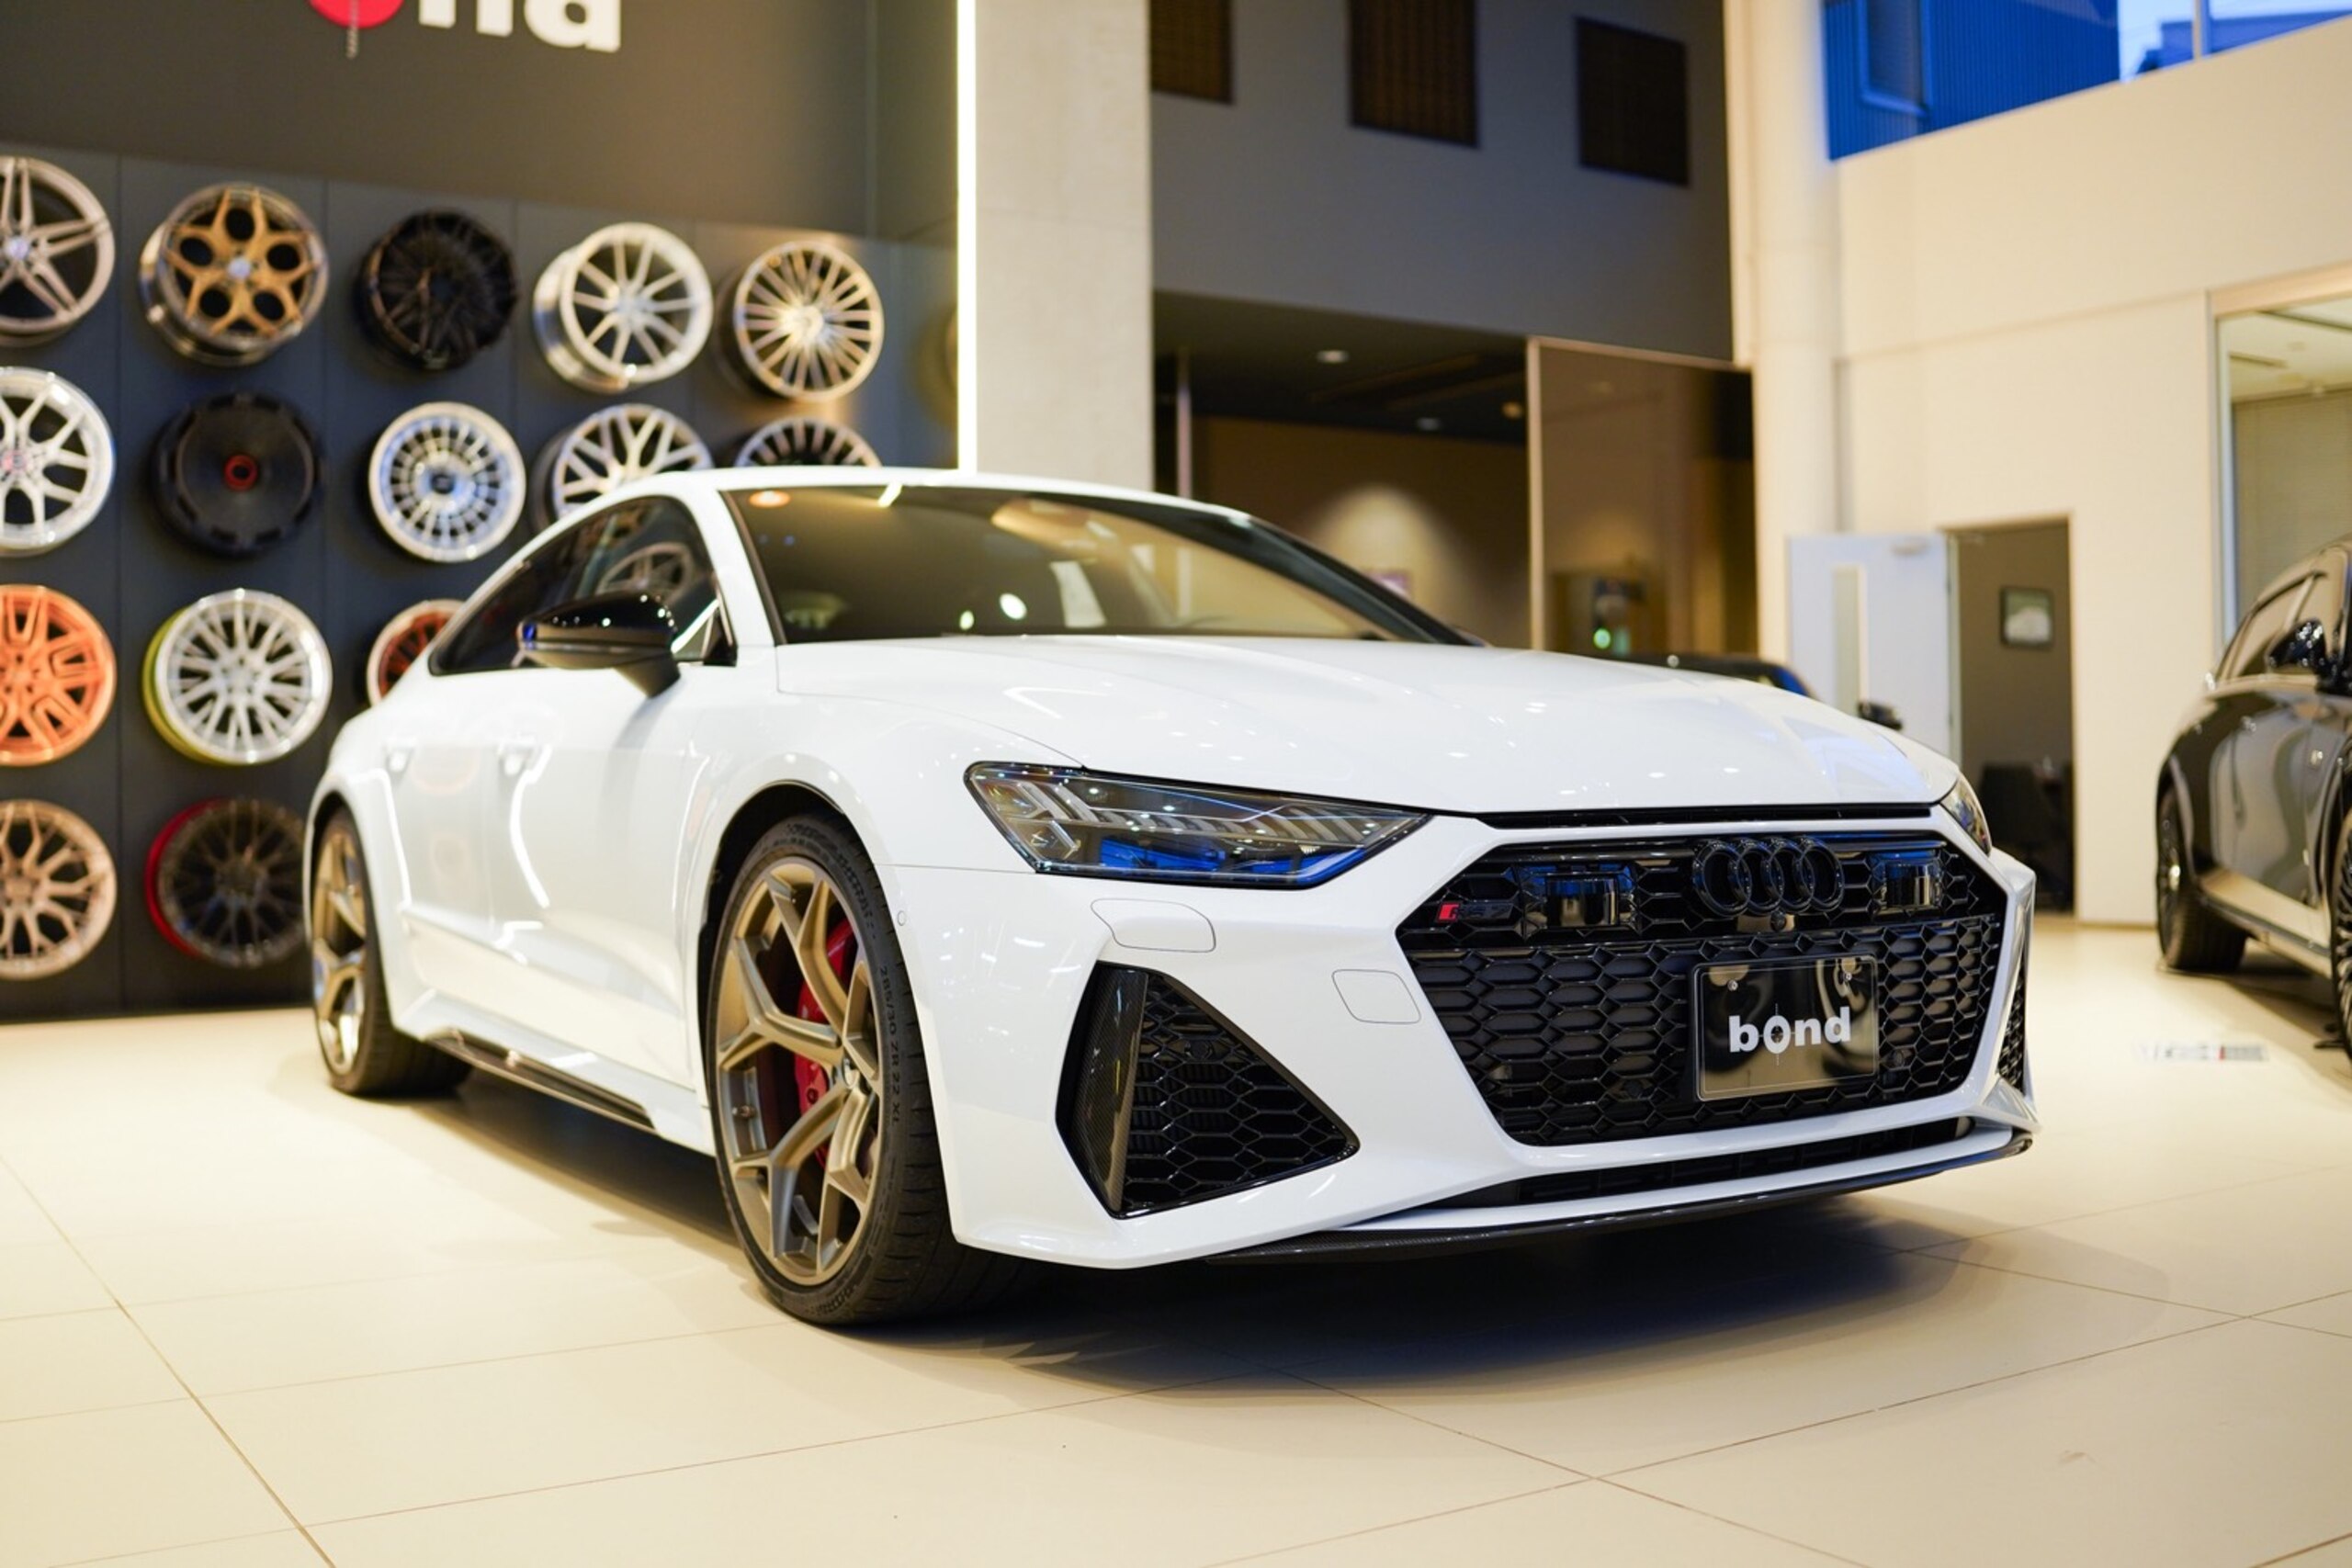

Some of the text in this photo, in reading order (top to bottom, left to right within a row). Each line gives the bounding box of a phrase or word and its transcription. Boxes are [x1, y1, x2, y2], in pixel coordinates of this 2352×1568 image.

[879, 965, 898, 1035] 285/30
[890, 1041, 900, 1066] ZR
[891, 1072, 901, 1095] 22
